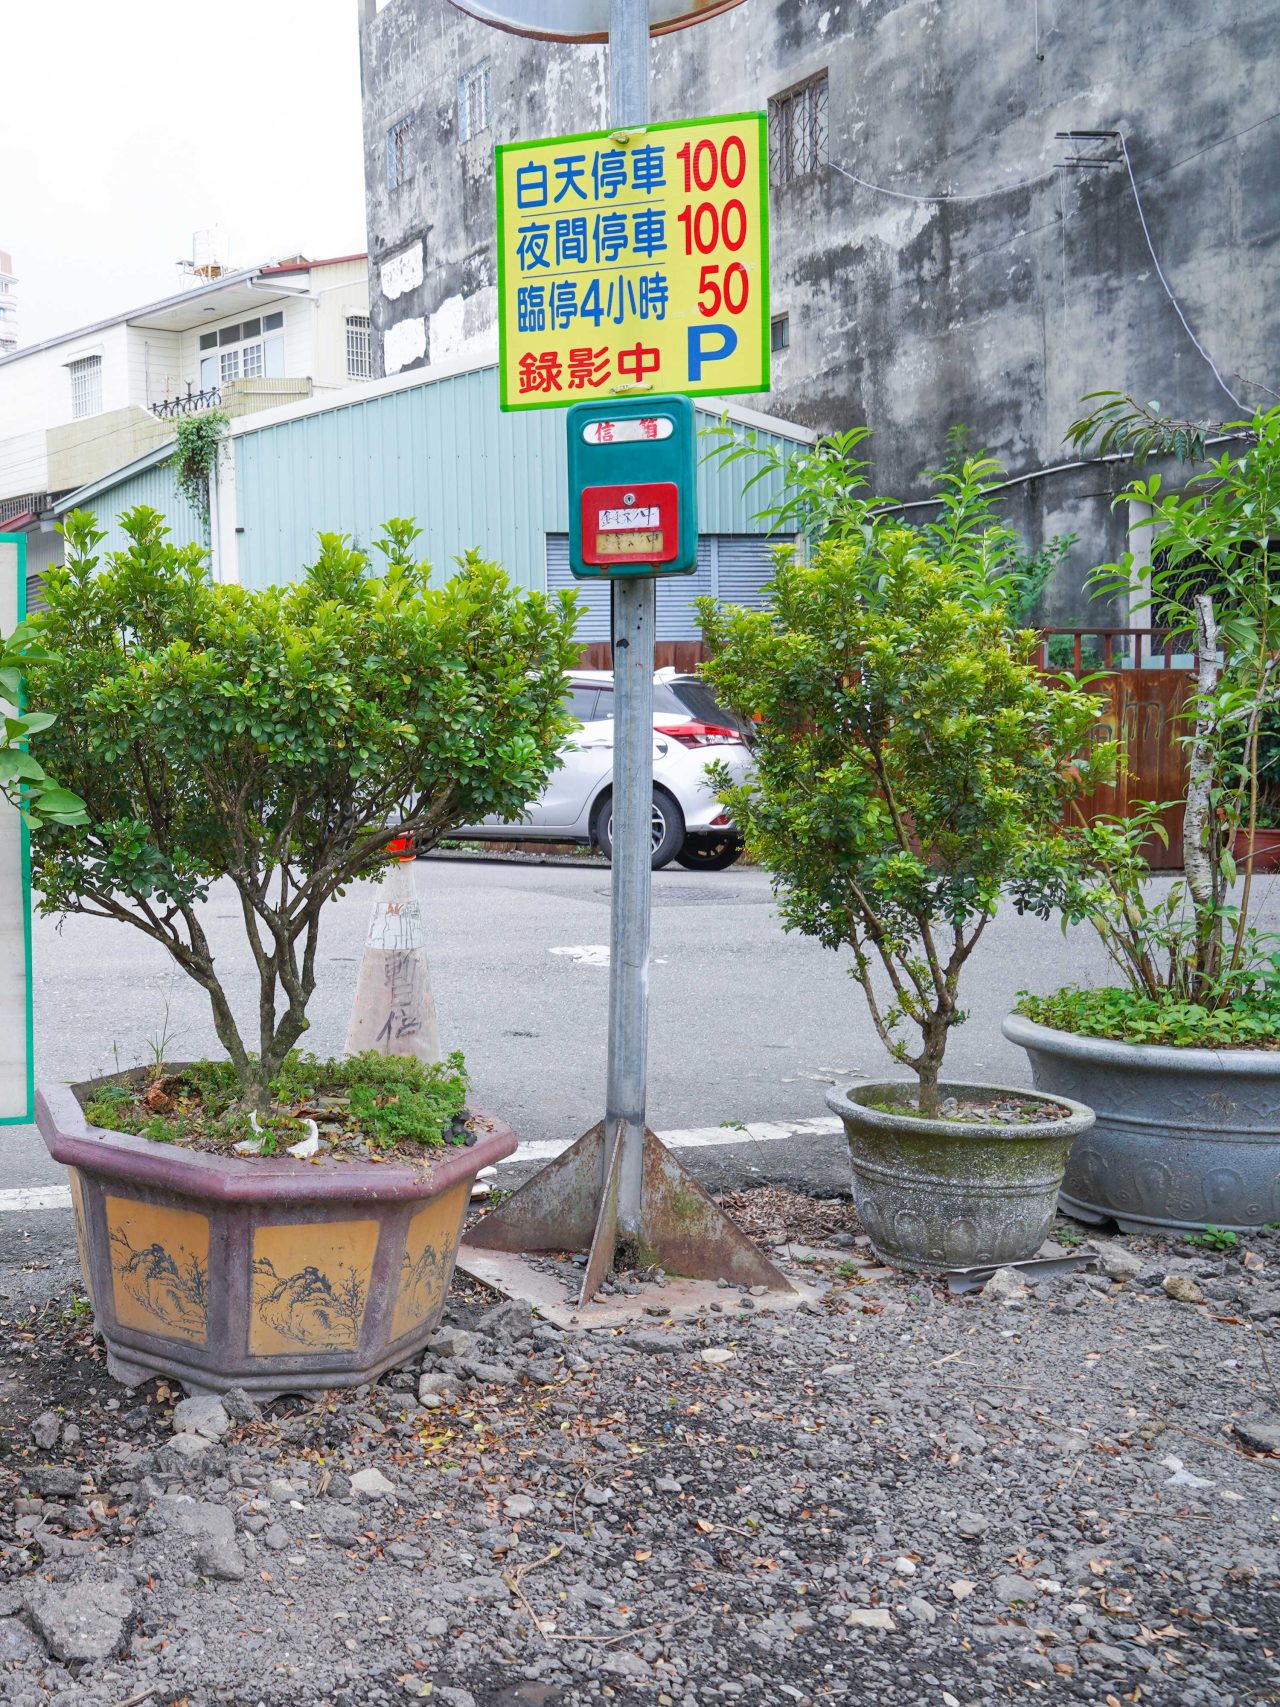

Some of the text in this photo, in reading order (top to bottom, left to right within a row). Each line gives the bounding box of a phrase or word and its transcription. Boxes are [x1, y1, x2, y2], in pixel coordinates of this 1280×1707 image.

[517, 136, 746, 209] 白天停車 100
[517, 199, 747, 271] 夜間停車 100
[517, 262, 749, 333] 臨停4小時 50
[519, 324, 738, 393] 錄影中 P
